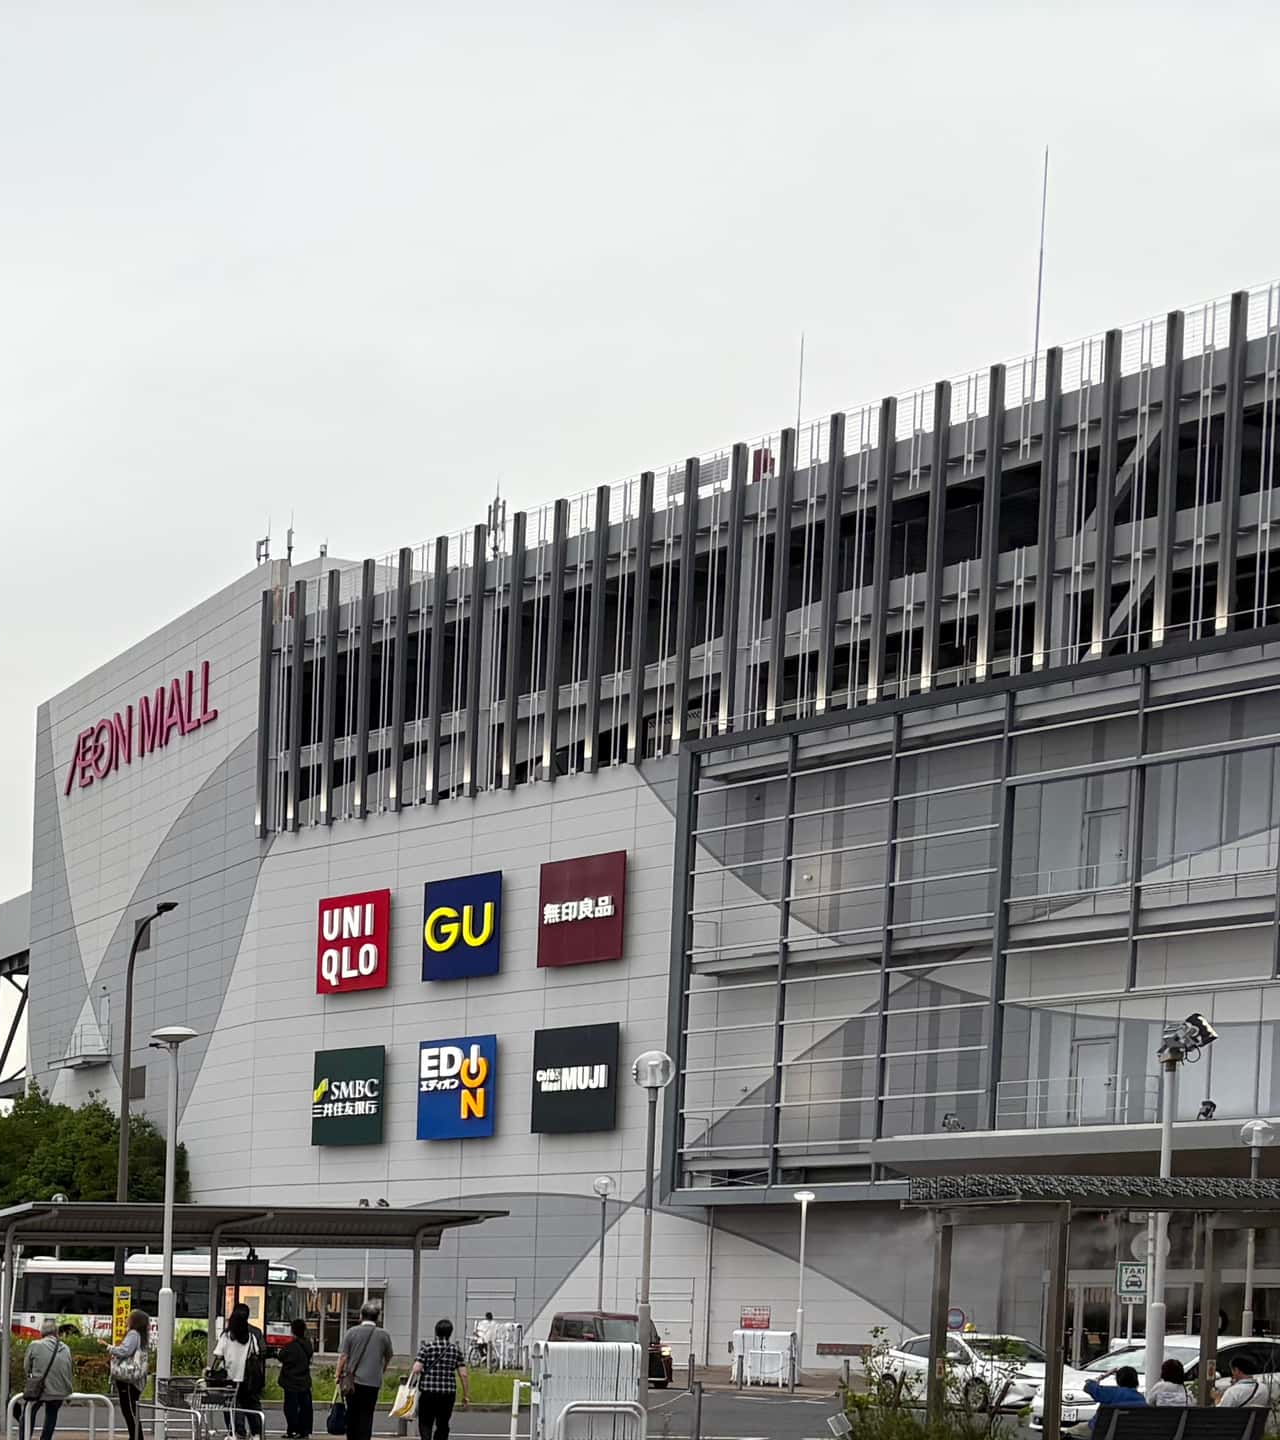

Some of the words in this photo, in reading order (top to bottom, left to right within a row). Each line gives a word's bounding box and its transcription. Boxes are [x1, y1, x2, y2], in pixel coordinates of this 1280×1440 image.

[138, 660, 219, 758] MALL
[322, 903, 375, 941] UNI
[543, 896, 615, 925] 無印良品
[425, 902, 494, 952] GU
[321, 943, 378, 986] QLO
[330, 1078, 380, 1101] SMBC
[420, 1078, 460, 1092] エディオン
[561, 1064, 609, 1091] MUJI
[312, 1100, 378, 1117] 三井住友銀行
[1124, 1267, 1145, 1275] TAXI
